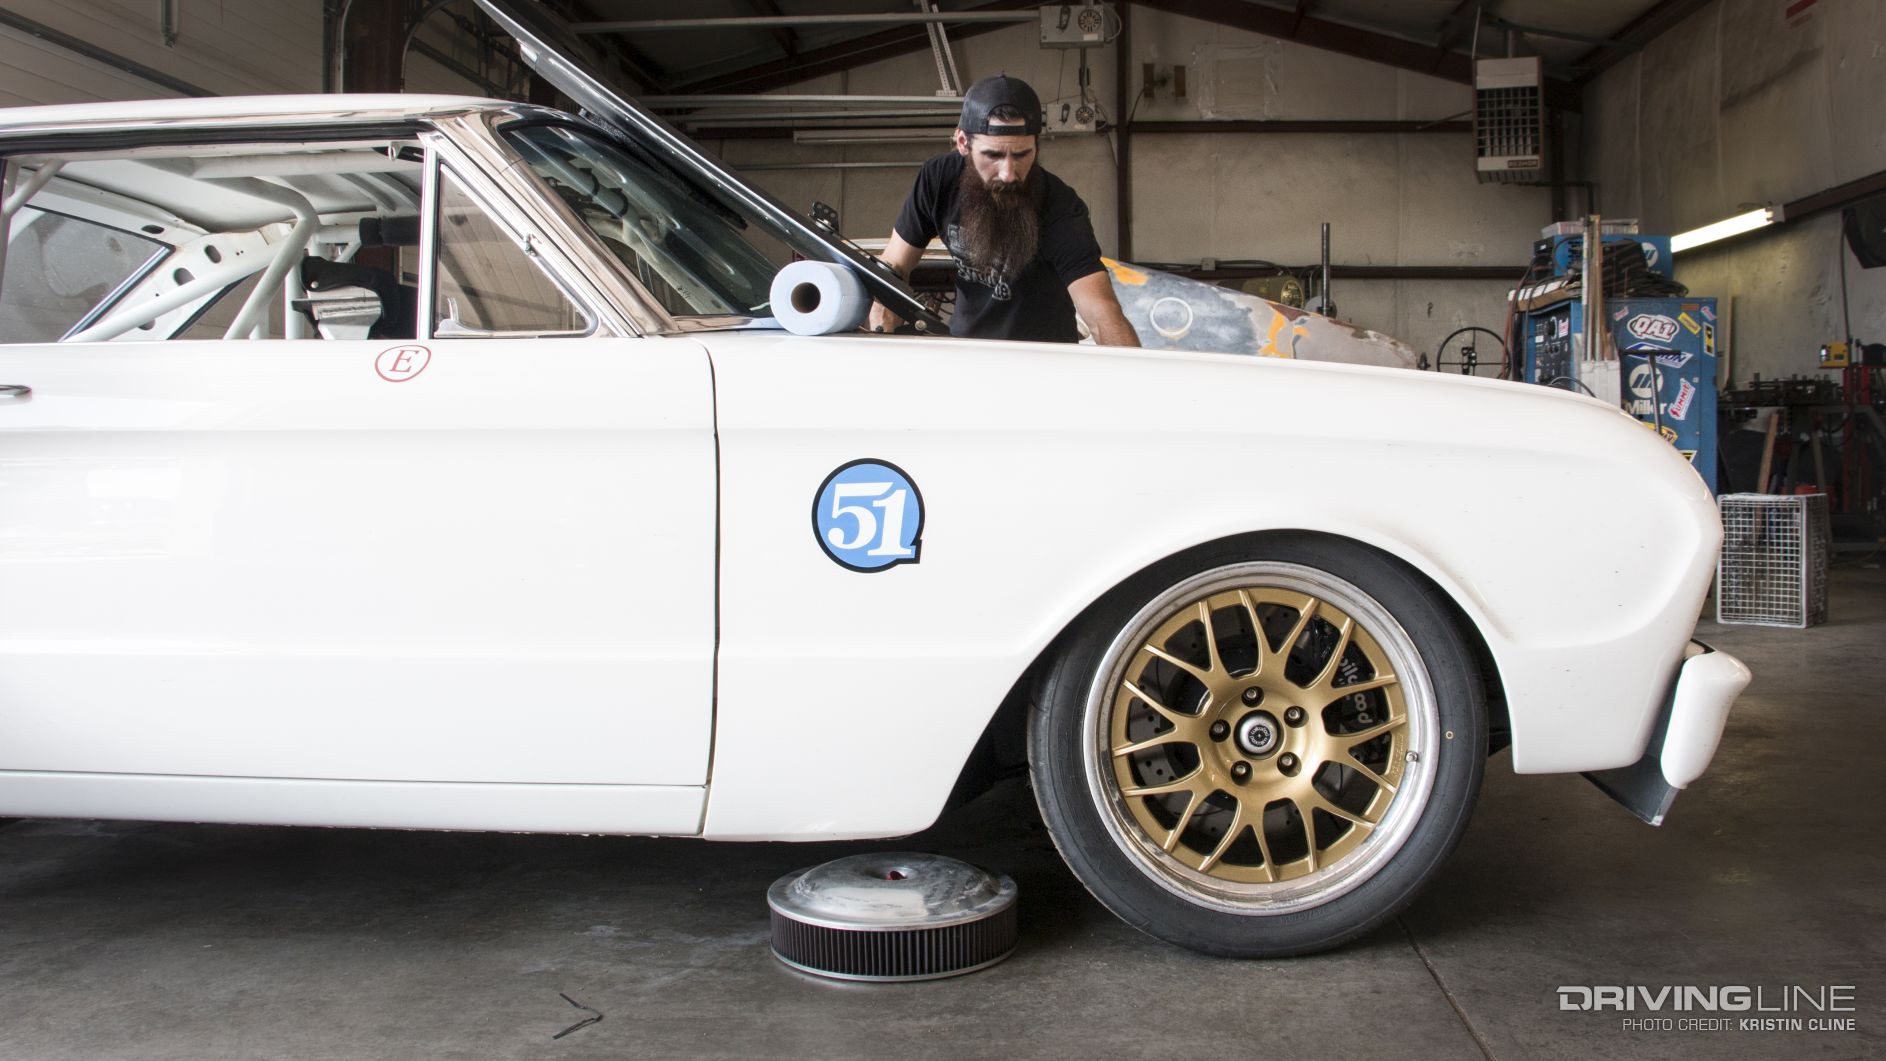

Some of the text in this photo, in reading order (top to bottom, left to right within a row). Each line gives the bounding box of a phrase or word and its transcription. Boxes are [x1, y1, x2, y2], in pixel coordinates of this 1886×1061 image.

[1633, 316, 1675, 340] QA1
[389, 350, 419, 373] E
[827, 481, 912, 556] 51
